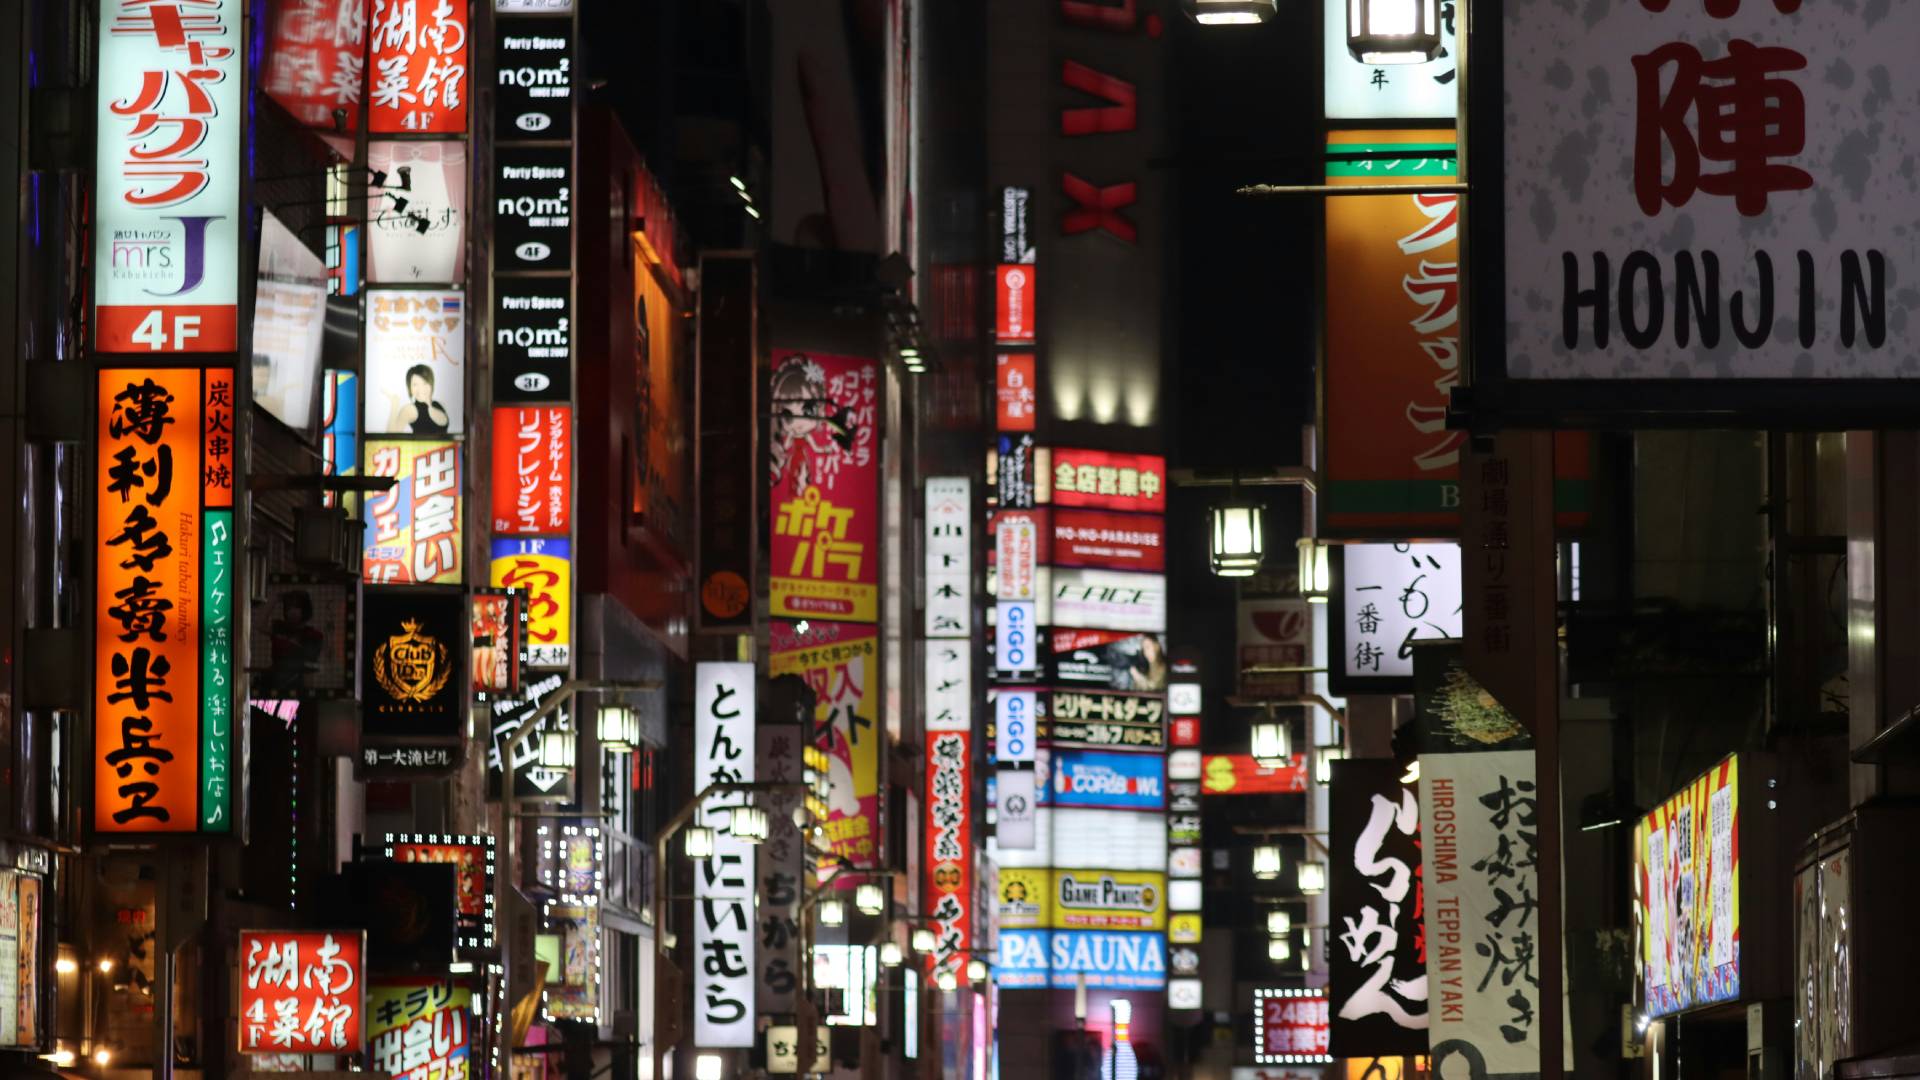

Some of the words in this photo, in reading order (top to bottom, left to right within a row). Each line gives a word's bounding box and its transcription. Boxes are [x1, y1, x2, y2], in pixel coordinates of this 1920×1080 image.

[504, 36, 531, 50] Party
[532, 36, 566, 50] Space
[110, 0, 234, 208] キャバクラ
[400, 111, 434, 130] 4F
[525, 117, 542, 128] 5F
[503, 166, 530, 180] Party
[531, 166, 565, 180] Space
[142, 216, 227, 297] J
[524, 247, 540, 257] 4F
[502, 296, 530, 310] Party
[531, 296, 565, 310] Space
[1562, 249, 1887, 350] HONJIN
[131, 309, 201, 351] 4F
[523, 377, 539, 388] 3F
[517, 409, 542, 532] リフレッシュ
[413, 447, 456, 583] 出会い
[520, 539, 546, 554] 1F
[368, 564, 400, 583] 1F
[1007, 606, 1025, 665] GiGO
[1354, 584, 1385, 672] 一番街
[393, 646, 432, 661] Club
[800, 640, 874, 667] 今すぐ見つかる
[1007, 696, 1024, 756] GiGO
[1432, 778, 1458, 884] HIROSHIMA
[1052, 934, 1166, 972] SAUNA
[246, 998, 267, 1048] 4F
[376, 981, 454, 1026] キラリ
[374, 1009, 463, 1076] 出会い
